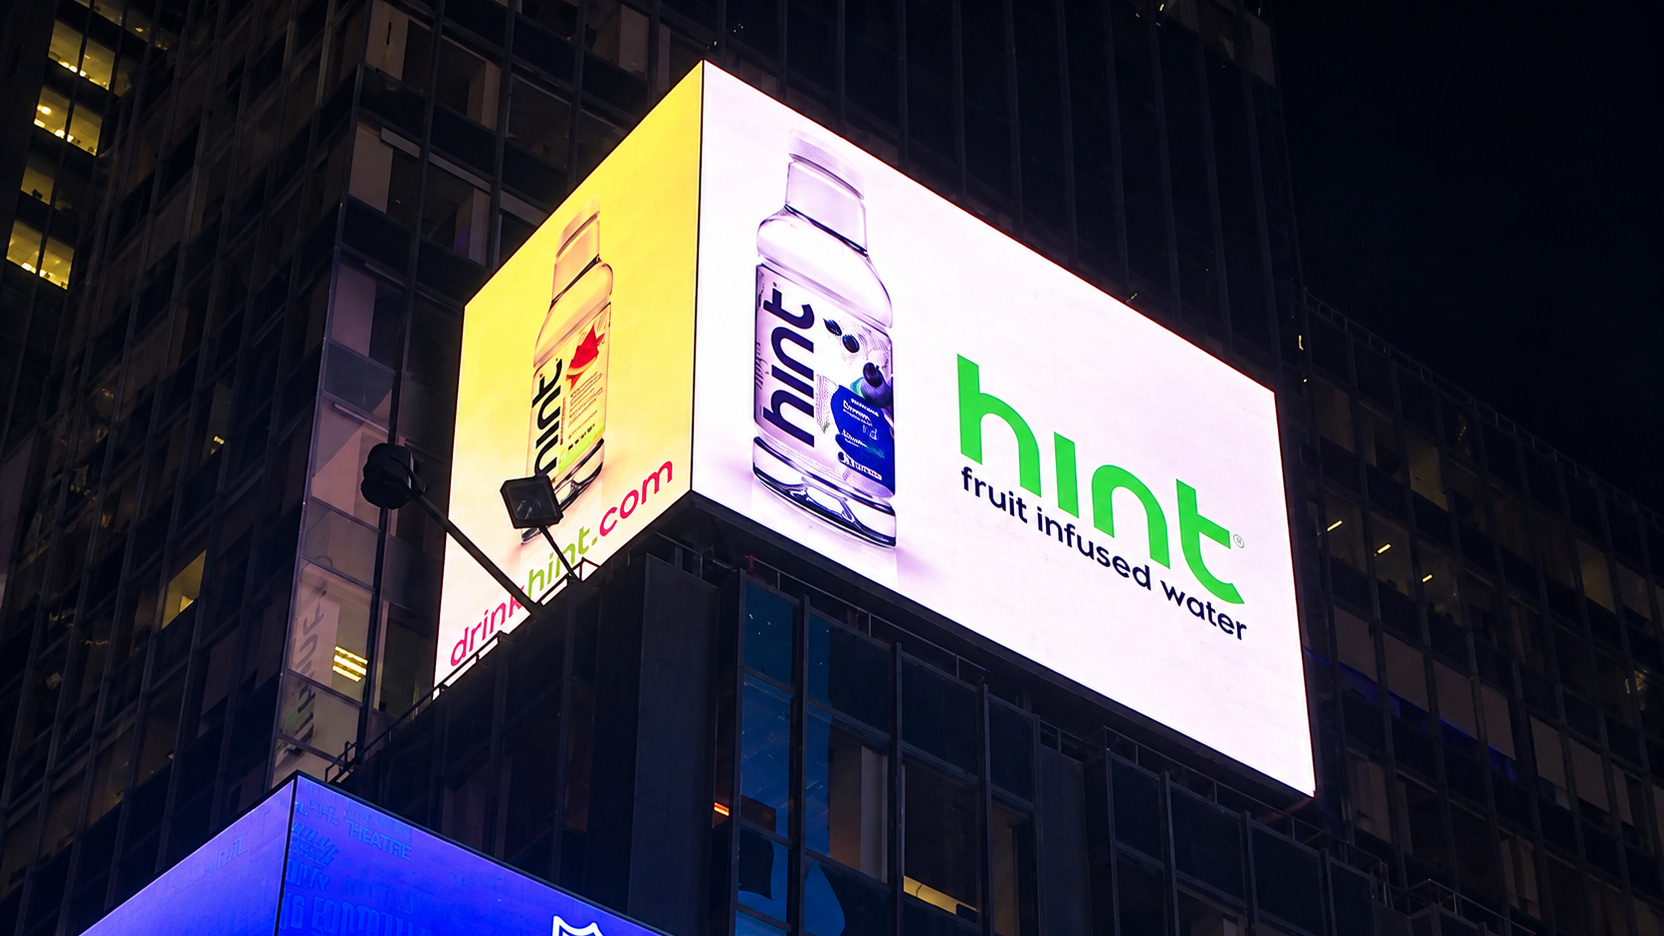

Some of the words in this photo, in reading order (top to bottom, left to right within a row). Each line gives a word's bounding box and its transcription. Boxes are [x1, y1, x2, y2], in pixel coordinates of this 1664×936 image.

[763, 287, 815, 447] hint
[956, 354, 1246, 605] hint
[961, 467, 1028, 524] fruit
[1036, 507, 1152, 591] infused
[1160, 580, 1247, 641] water
